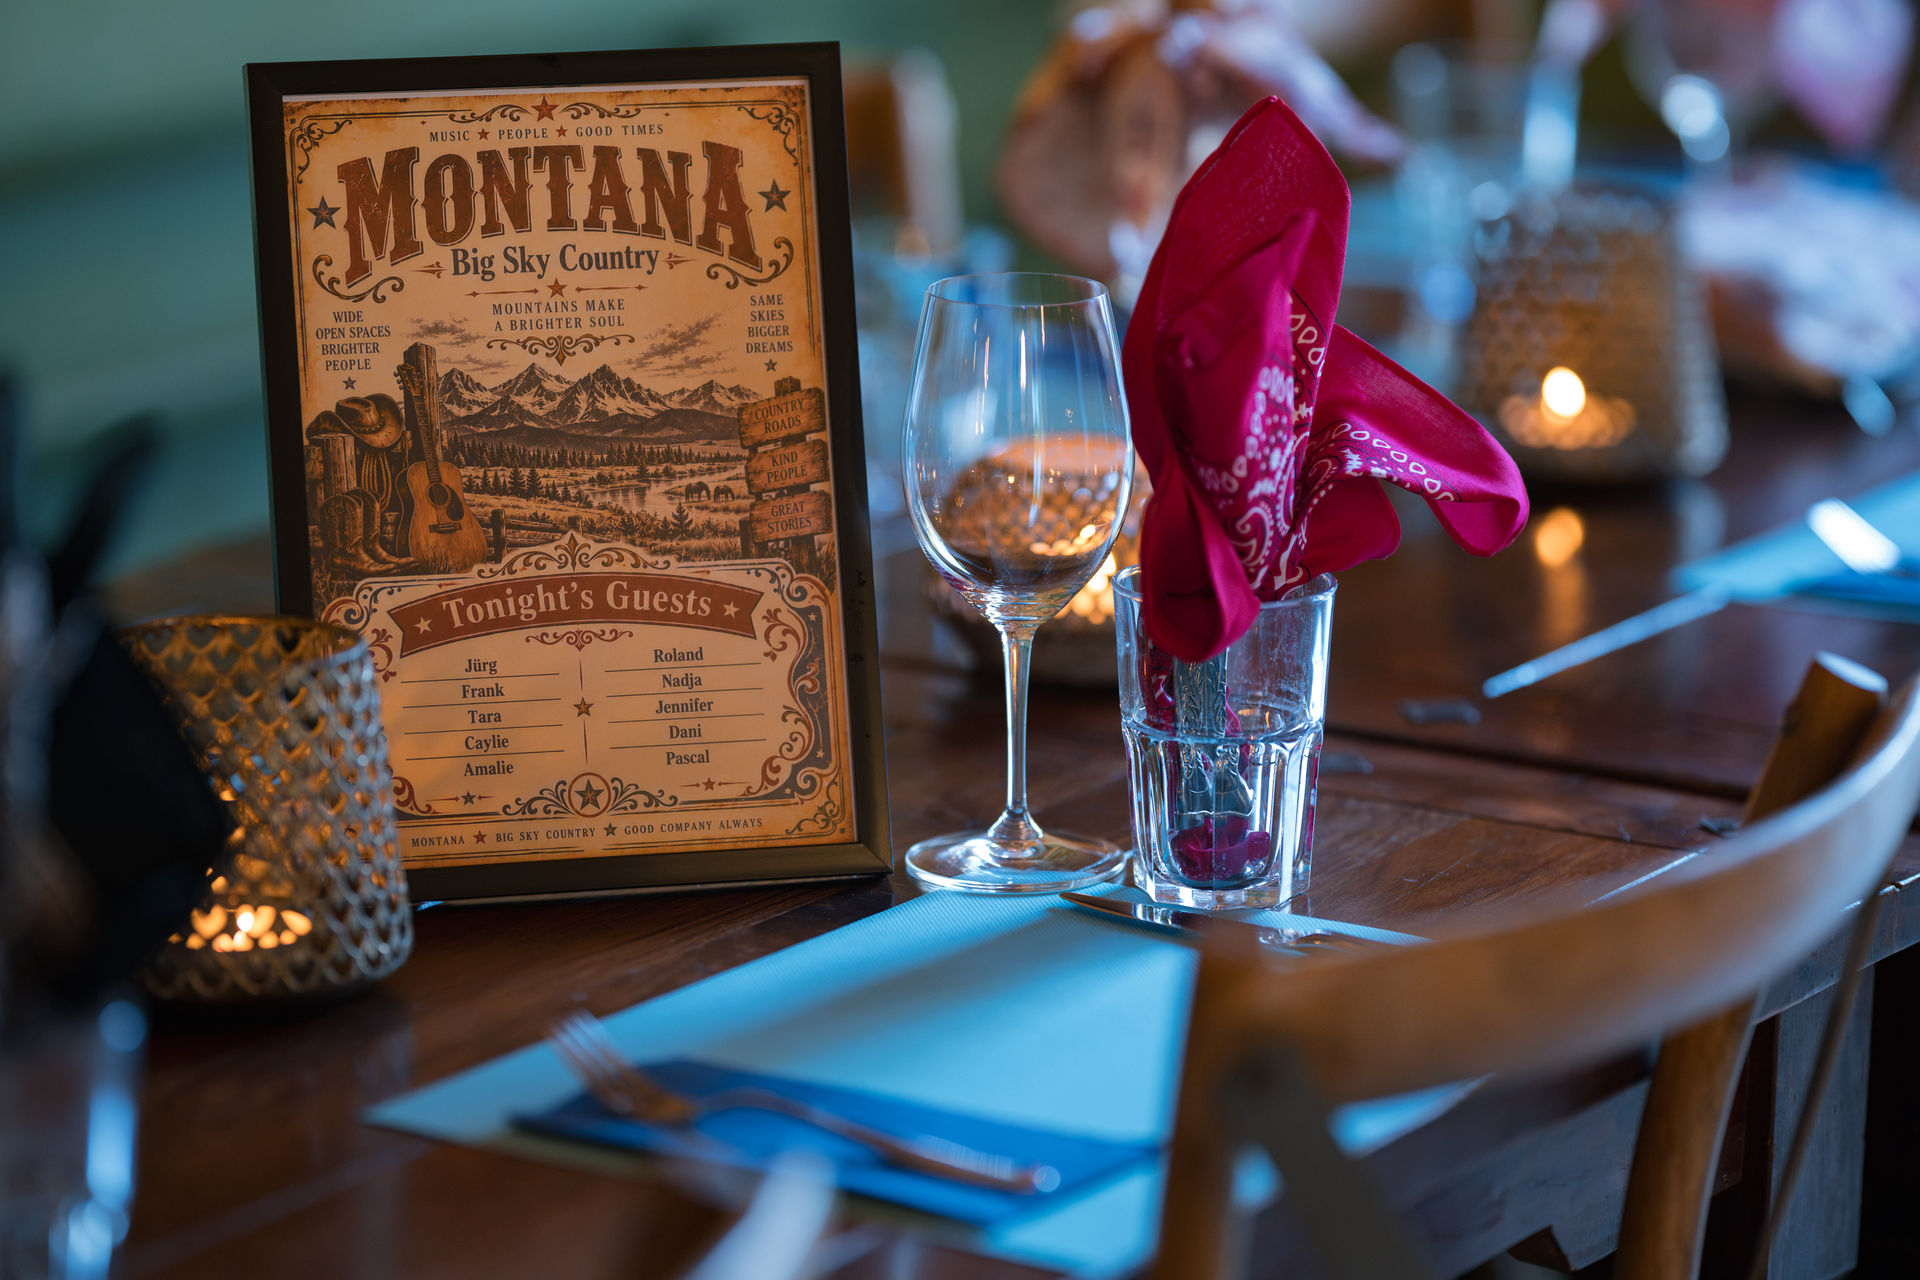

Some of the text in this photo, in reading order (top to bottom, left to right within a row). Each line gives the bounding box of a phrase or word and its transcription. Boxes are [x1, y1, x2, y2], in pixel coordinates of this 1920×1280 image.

[429, 124, 664, 142] MUSIC PEOPLE GOOD TIMES
[337, 140, 762, 287] MONTANA
[451, 243, 660, 281] Big Sky Country
[492, 299, 625, 315] MOUNTAINS MAKE
[750, 294, 783, 306] SAME
[333, 311, 363, 323] WIDE
[495, 315, 625, 331] A BRIGHTER SOUL
[750, 310, 785, 322] SKIES
[316, 326, 391, 339] OPEN SPACES
[748, 325, 790, 338] BIGGER
[321, 341, 380, 355] BRIGHTER
[745, 341, 793, 354] DREAMS
[325, 357, 371, 371] PEOPLE
[754, 399, 804, 420] COUNTRY
[764, 415, 801, 434] ROADS
[771, 452, 798, 466] KIND
[766, 465, 807, 483] PEOPLE
[770, 501, 806, 518] GREAT
[768, 515, 812, 533] STORIES
[606, 581, 711, 617] Guests
[654, 647, 704, 663] Roland
[464, 657, 497, 676] Jürg
[662, 673, 703, 691] Nadja
[461, 683, 504, 699] Frank
[655, 698, 714, 714] Jennifer
[467, 710, 501, 724] Tara
[669, 724, 702, 739] Dani
[464, 735, 509, 752] Caylie
[665, 750, 710, 765] Pascal
[463, 761, 514, 777] Amalie
[411, 818, 763, 847] MONTANA BIG SKY COUNTRY GOOD COMPANY ALWAYS
